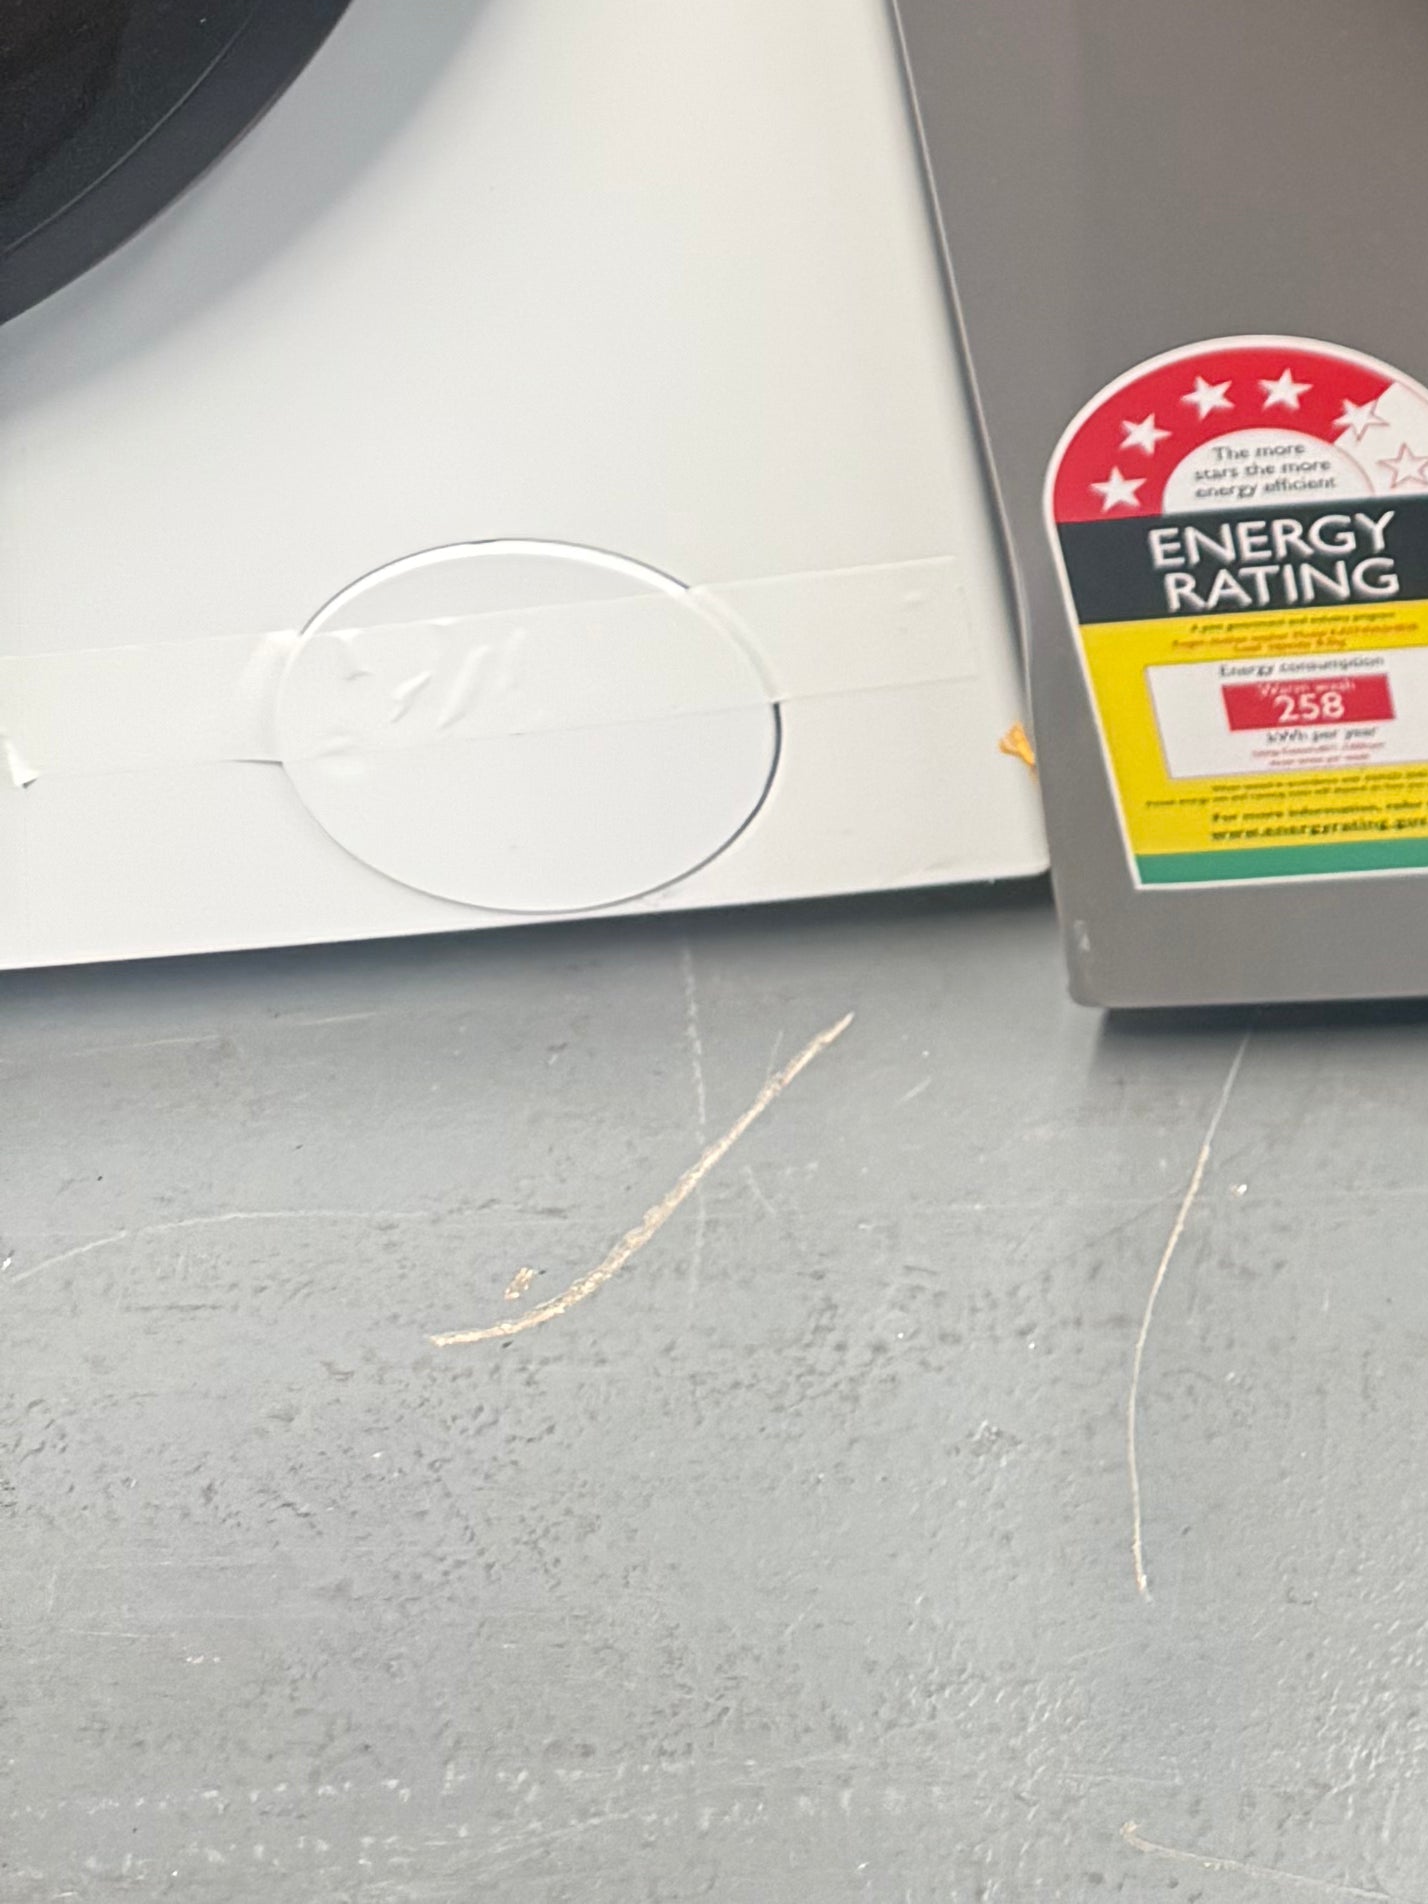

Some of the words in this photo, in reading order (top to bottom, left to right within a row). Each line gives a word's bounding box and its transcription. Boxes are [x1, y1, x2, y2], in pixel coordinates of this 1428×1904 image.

[1212, 445, 1250, 461] The
[1255, 444, 1305, 457] more
[1195, 465, 1238, 481] stars
[1245, 462, 1275, 476] the
[1281, 460, 1331, 473] more
[1195, 483, 1257, 498] energy
[1264, 477, 1336, 493] efficient
[1147, 510, 1396, 570] ENERGY
[1164, 556, 1399, 613] RATING
[1274, 691, 1345, 723] 258
